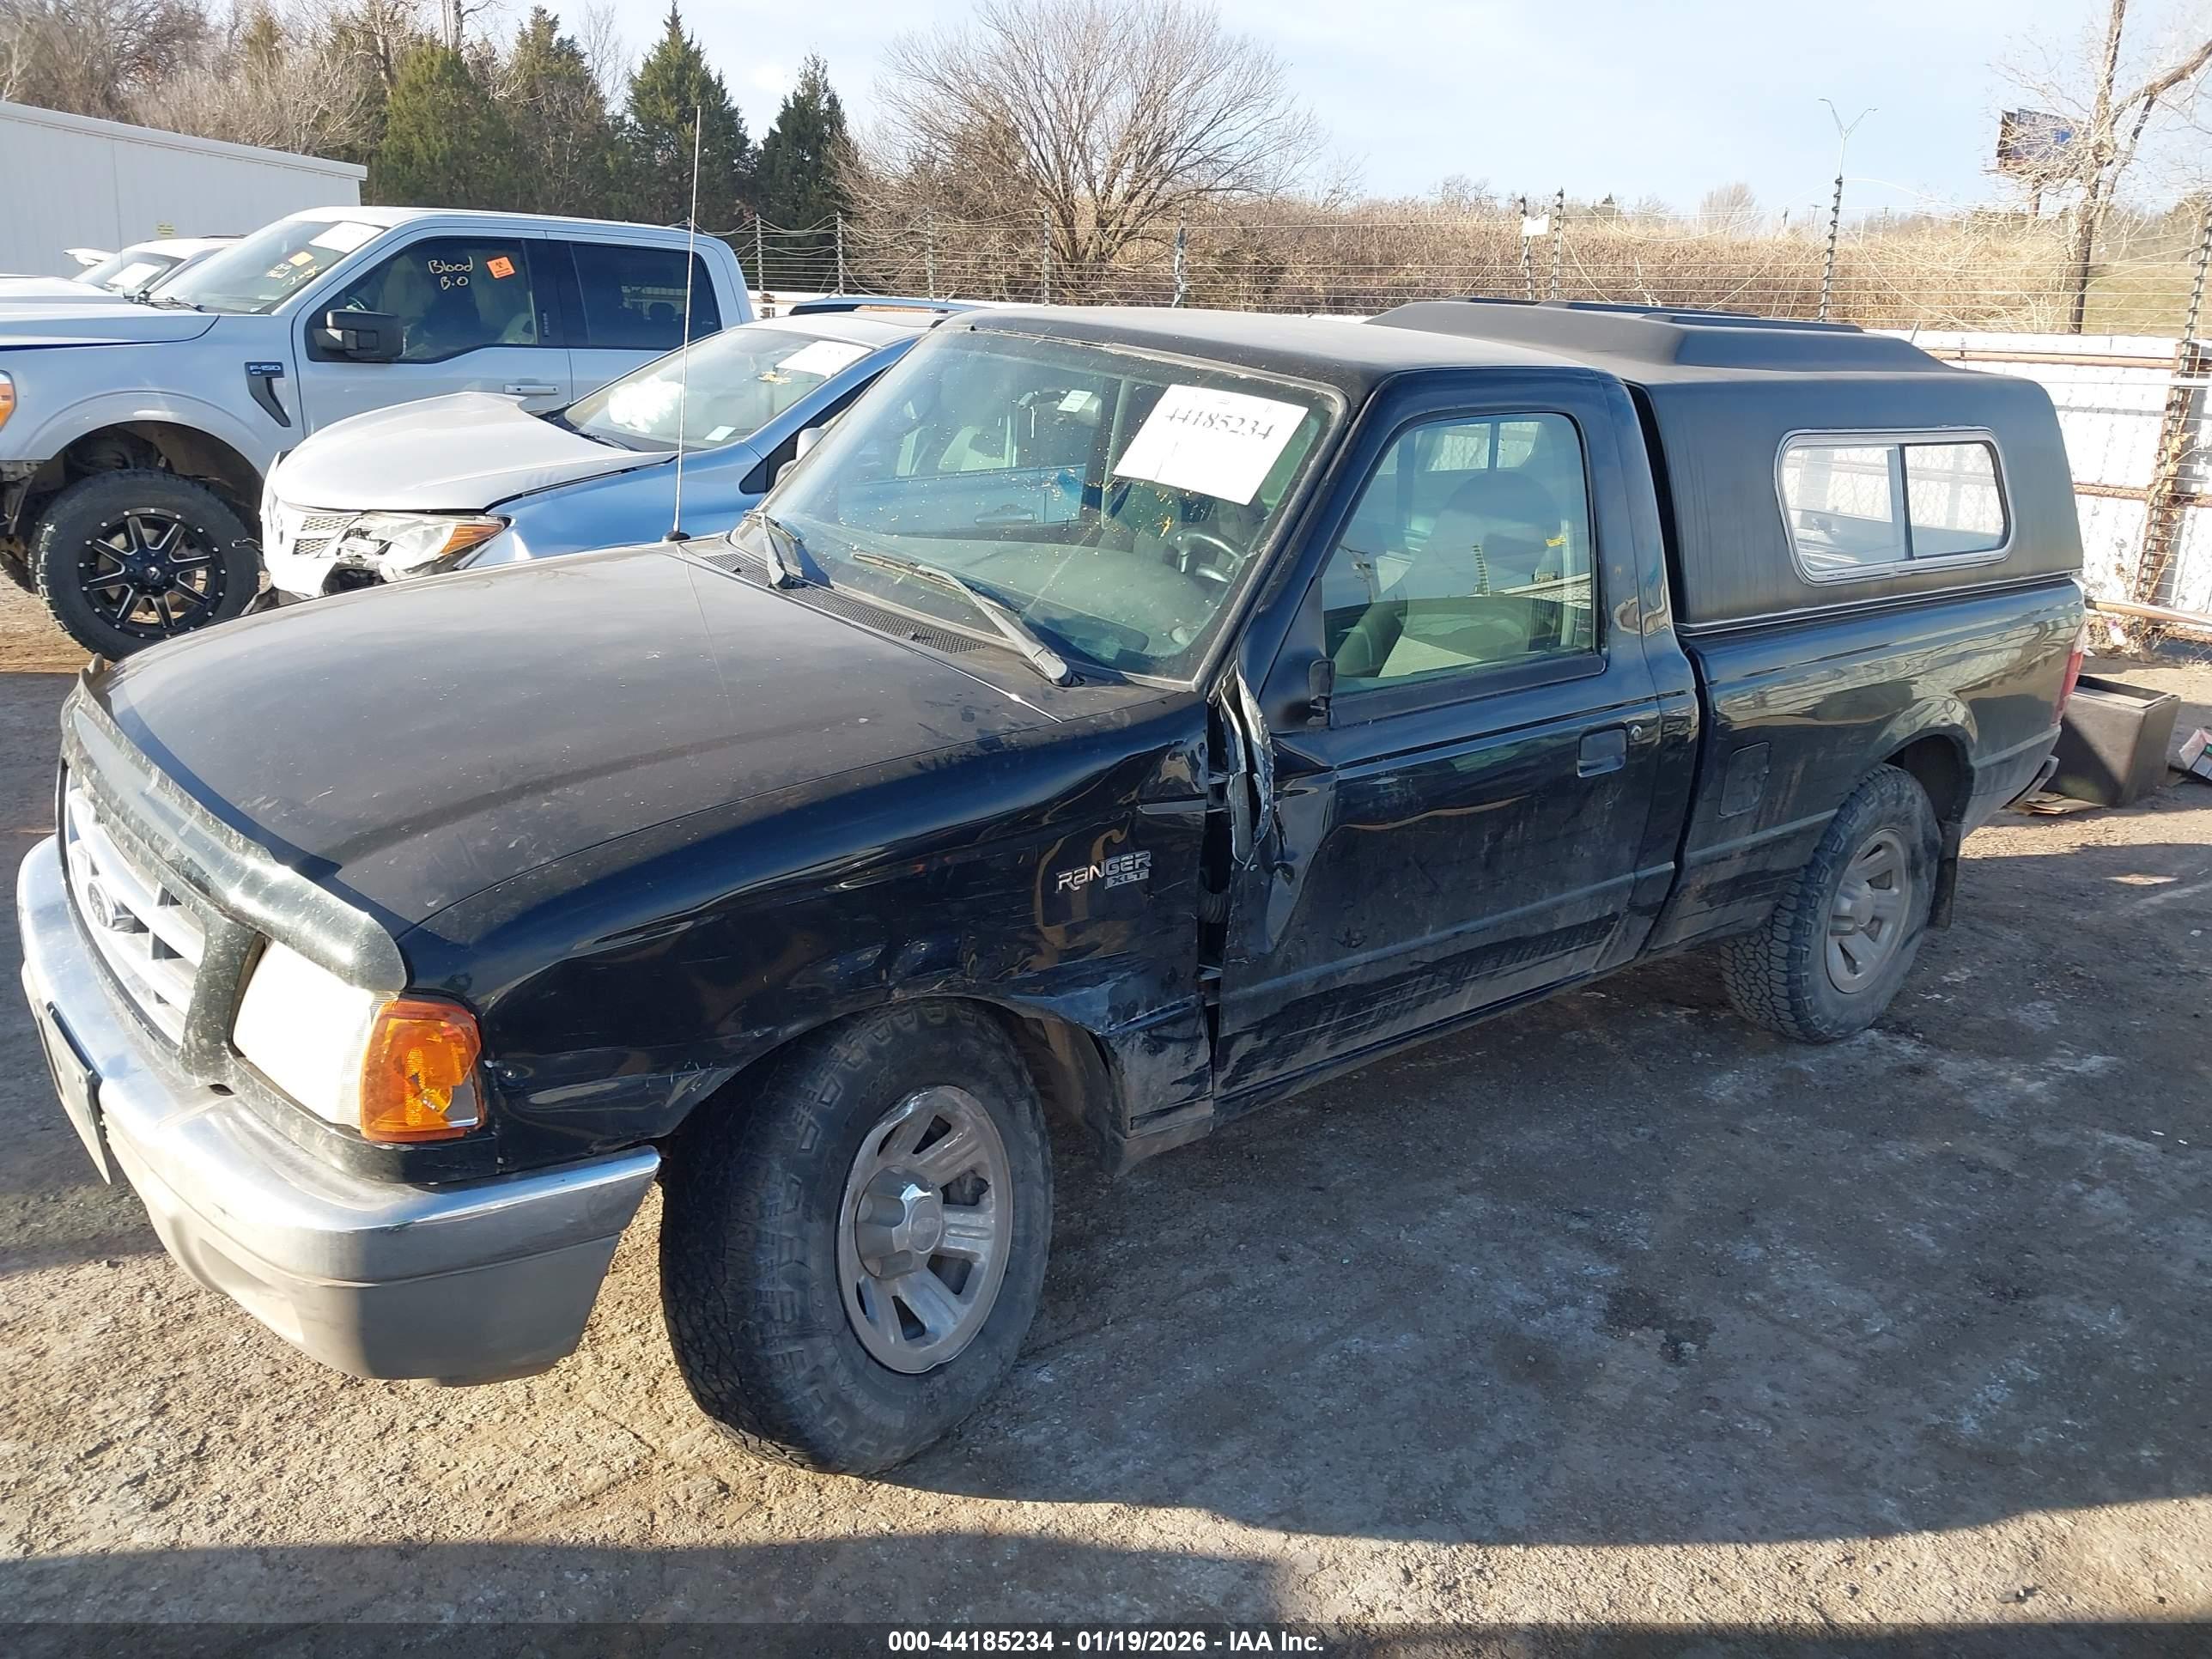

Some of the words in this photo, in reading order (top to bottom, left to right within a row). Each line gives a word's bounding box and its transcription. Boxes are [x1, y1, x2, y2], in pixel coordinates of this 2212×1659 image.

[428, 256, 473, 274] Blood
[1166, 407, 1274, 440] 44185234
[1057, 850, 1152, 891] RANGER
[1109, 870, 1146, 886] XLT
